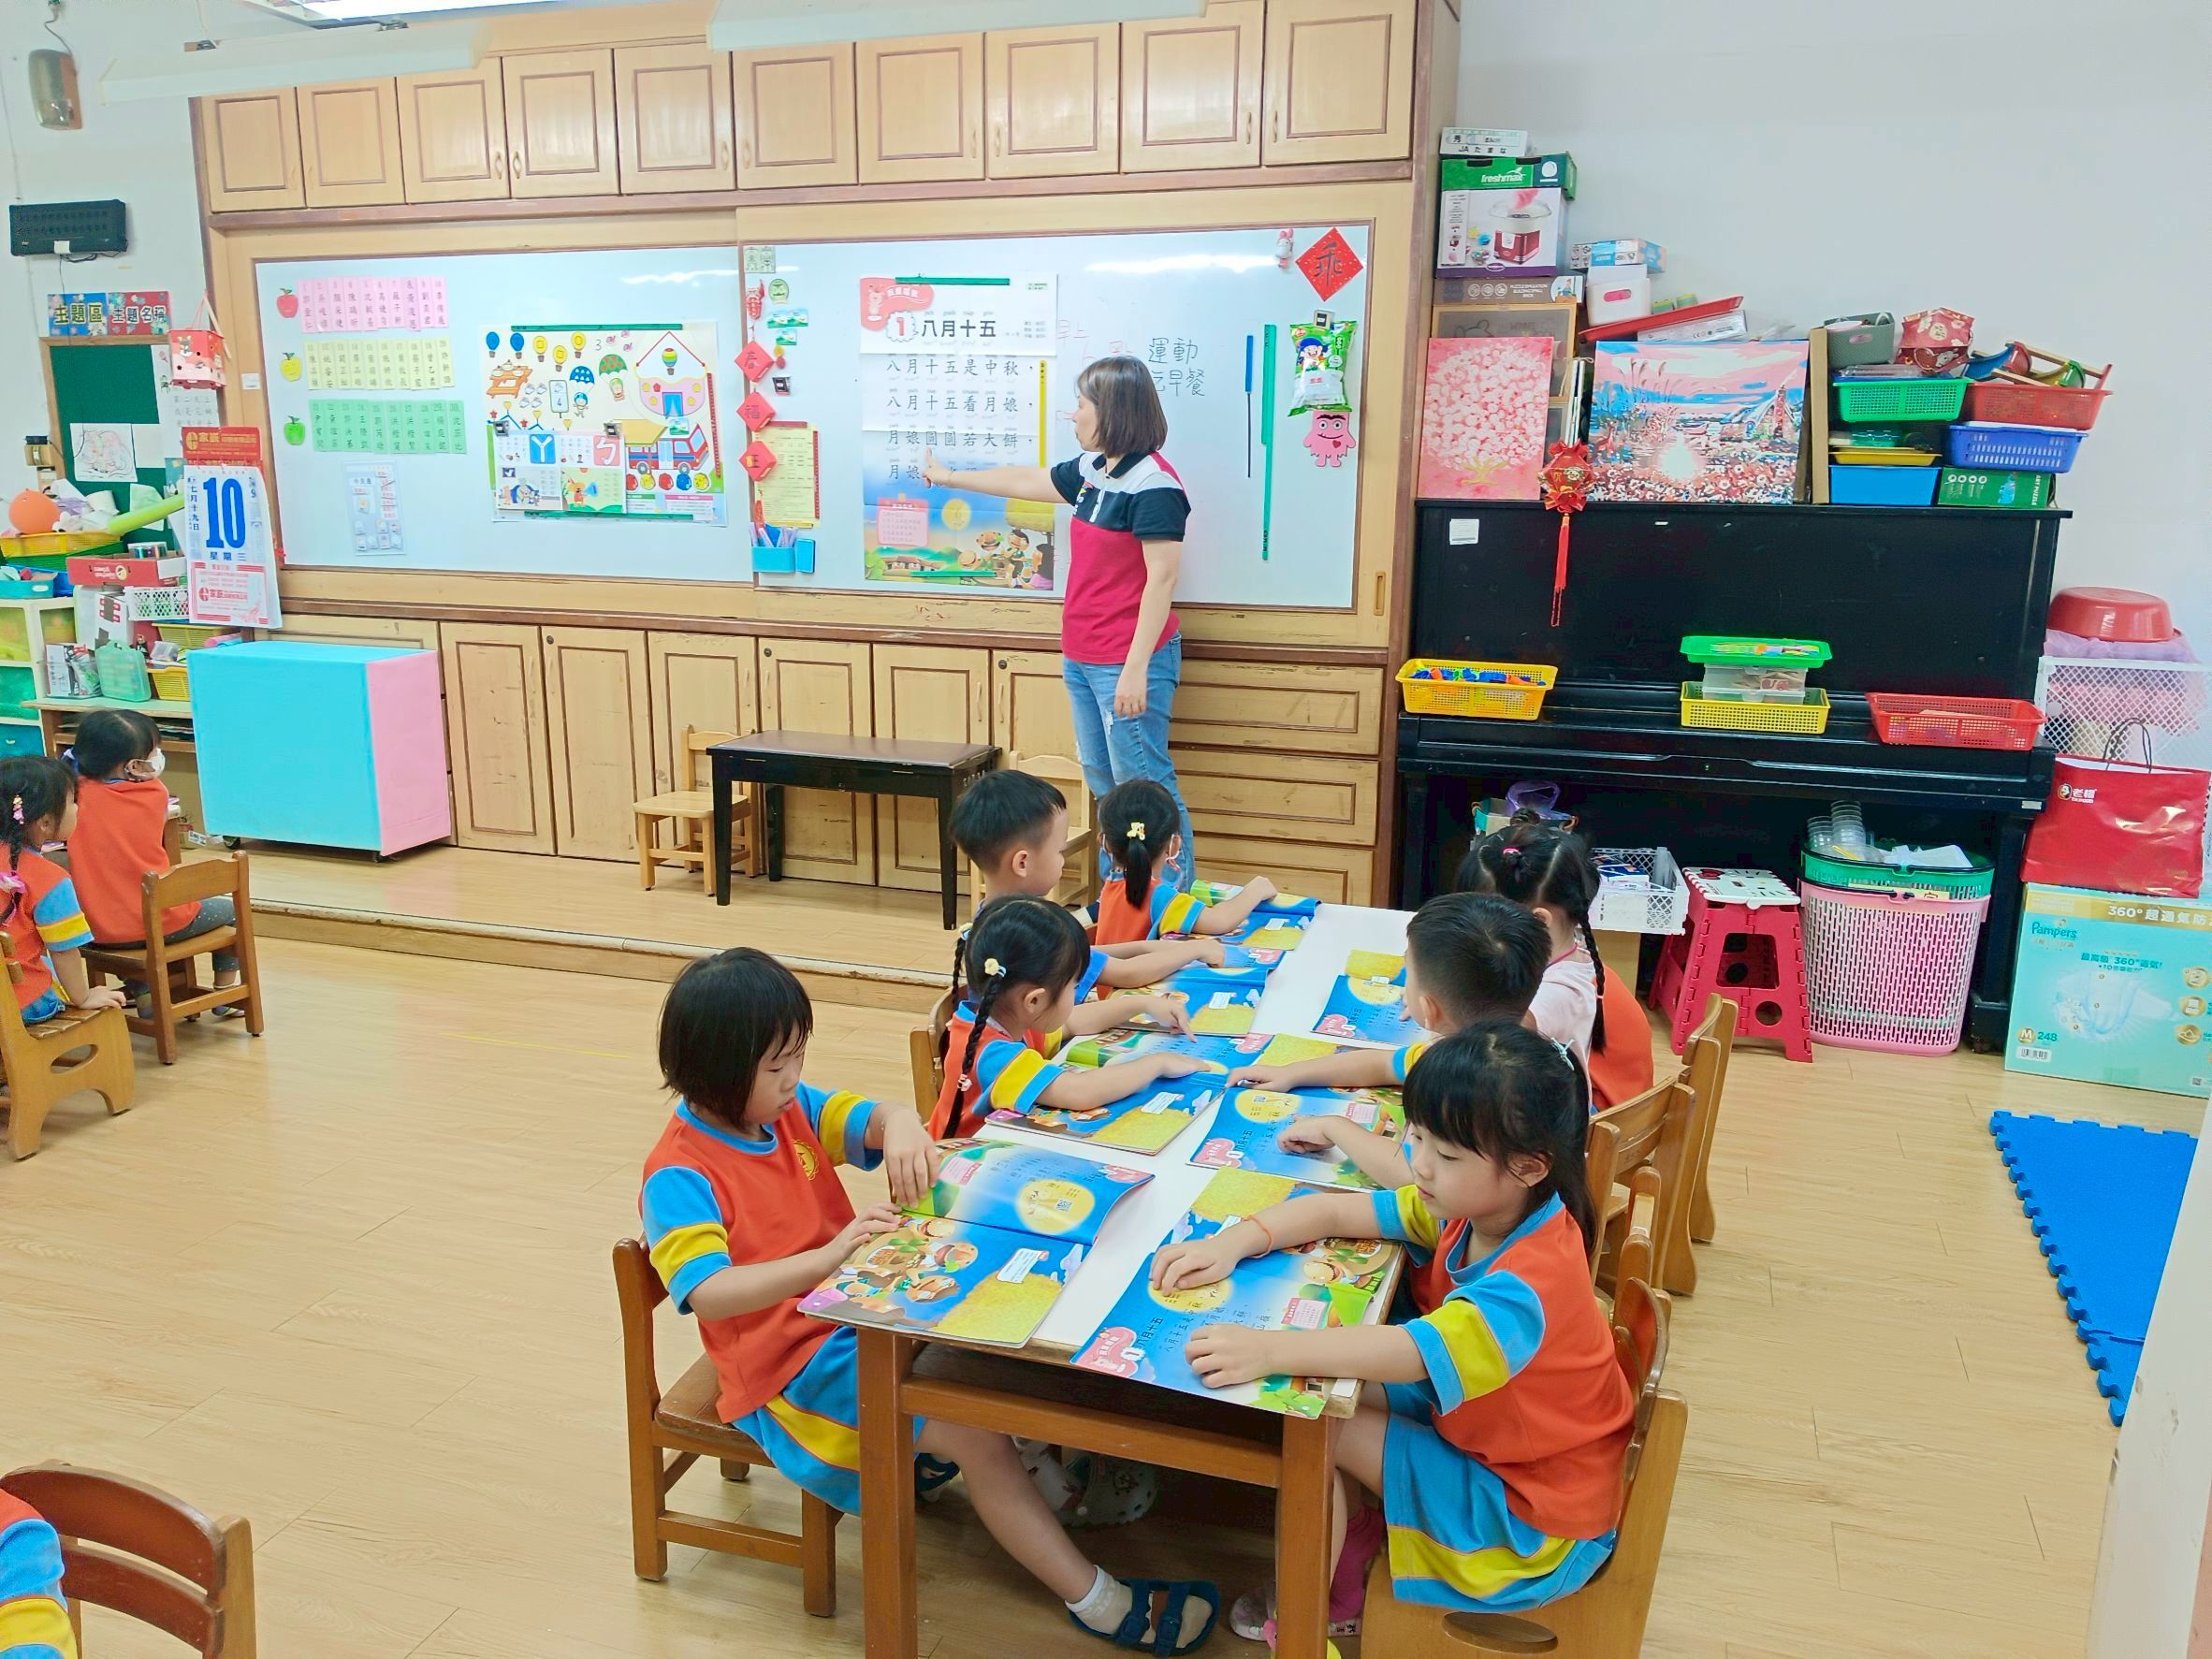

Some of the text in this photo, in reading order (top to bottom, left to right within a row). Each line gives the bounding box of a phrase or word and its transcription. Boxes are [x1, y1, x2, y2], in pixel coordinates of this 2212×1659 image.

[1314, 241, 1344, 289] 乖
[54, 303, 103, 324] 主題區
[111, 306, 167, 324] 主題名稱
[895, 316, 905, 337] 1
[921, 319, 997, 339] 八月十五
[594, 339, 603, 351] 3
[1148, 337, 1199, 365] 運動
[558, 397, 563, 407] 4
[203, 477, 246, 548] 10
[210, 552, 246, 561] 星期三
[2031, 921, 2078, 939] Pampers
[2020, 1028, 2032, 1040] M
[2037, 1031, 2059, 1042] 248
[1136, 1317, 1164, 1347] 八月十五
